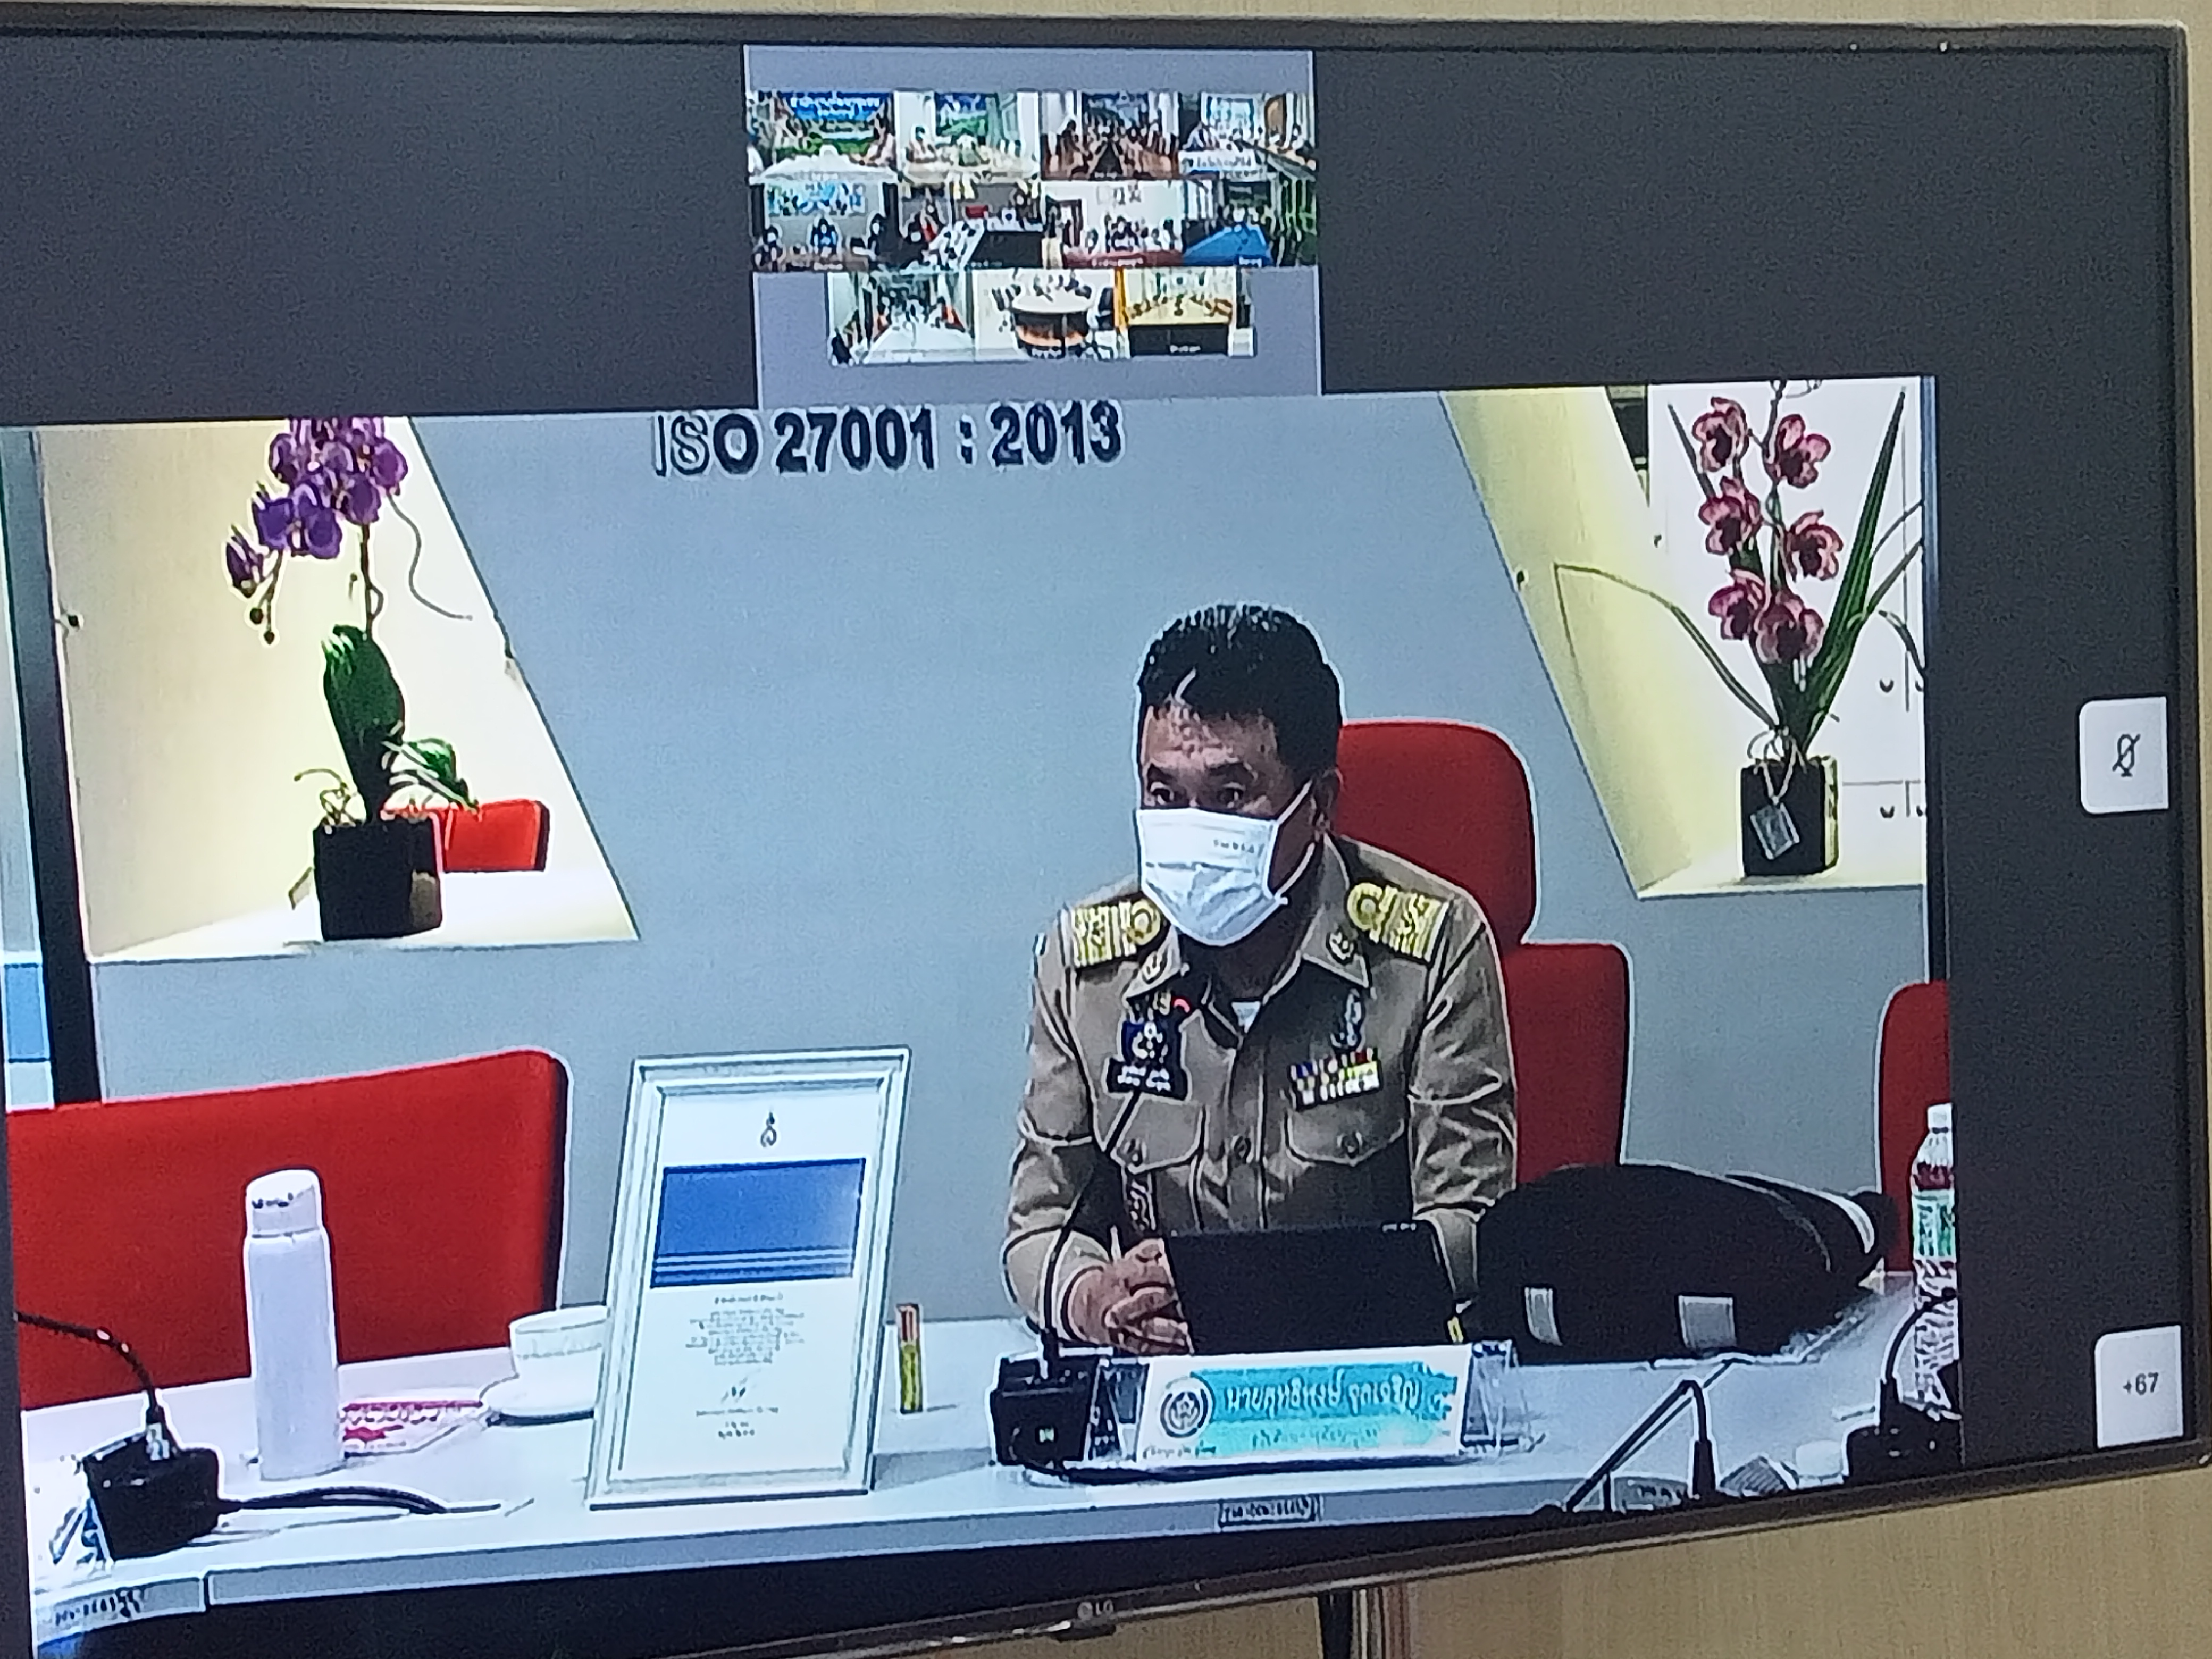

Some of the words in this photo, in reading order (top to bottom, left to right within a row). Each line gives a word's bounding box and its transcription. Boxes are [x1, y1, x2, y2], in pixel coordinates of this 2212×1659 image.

[655, 414, 759, 476] ISO
[775, 408, 935, 473] 27001
[990, 401, 1124, 466] 2013
[2123, 1371, 2159, 1395] +67
